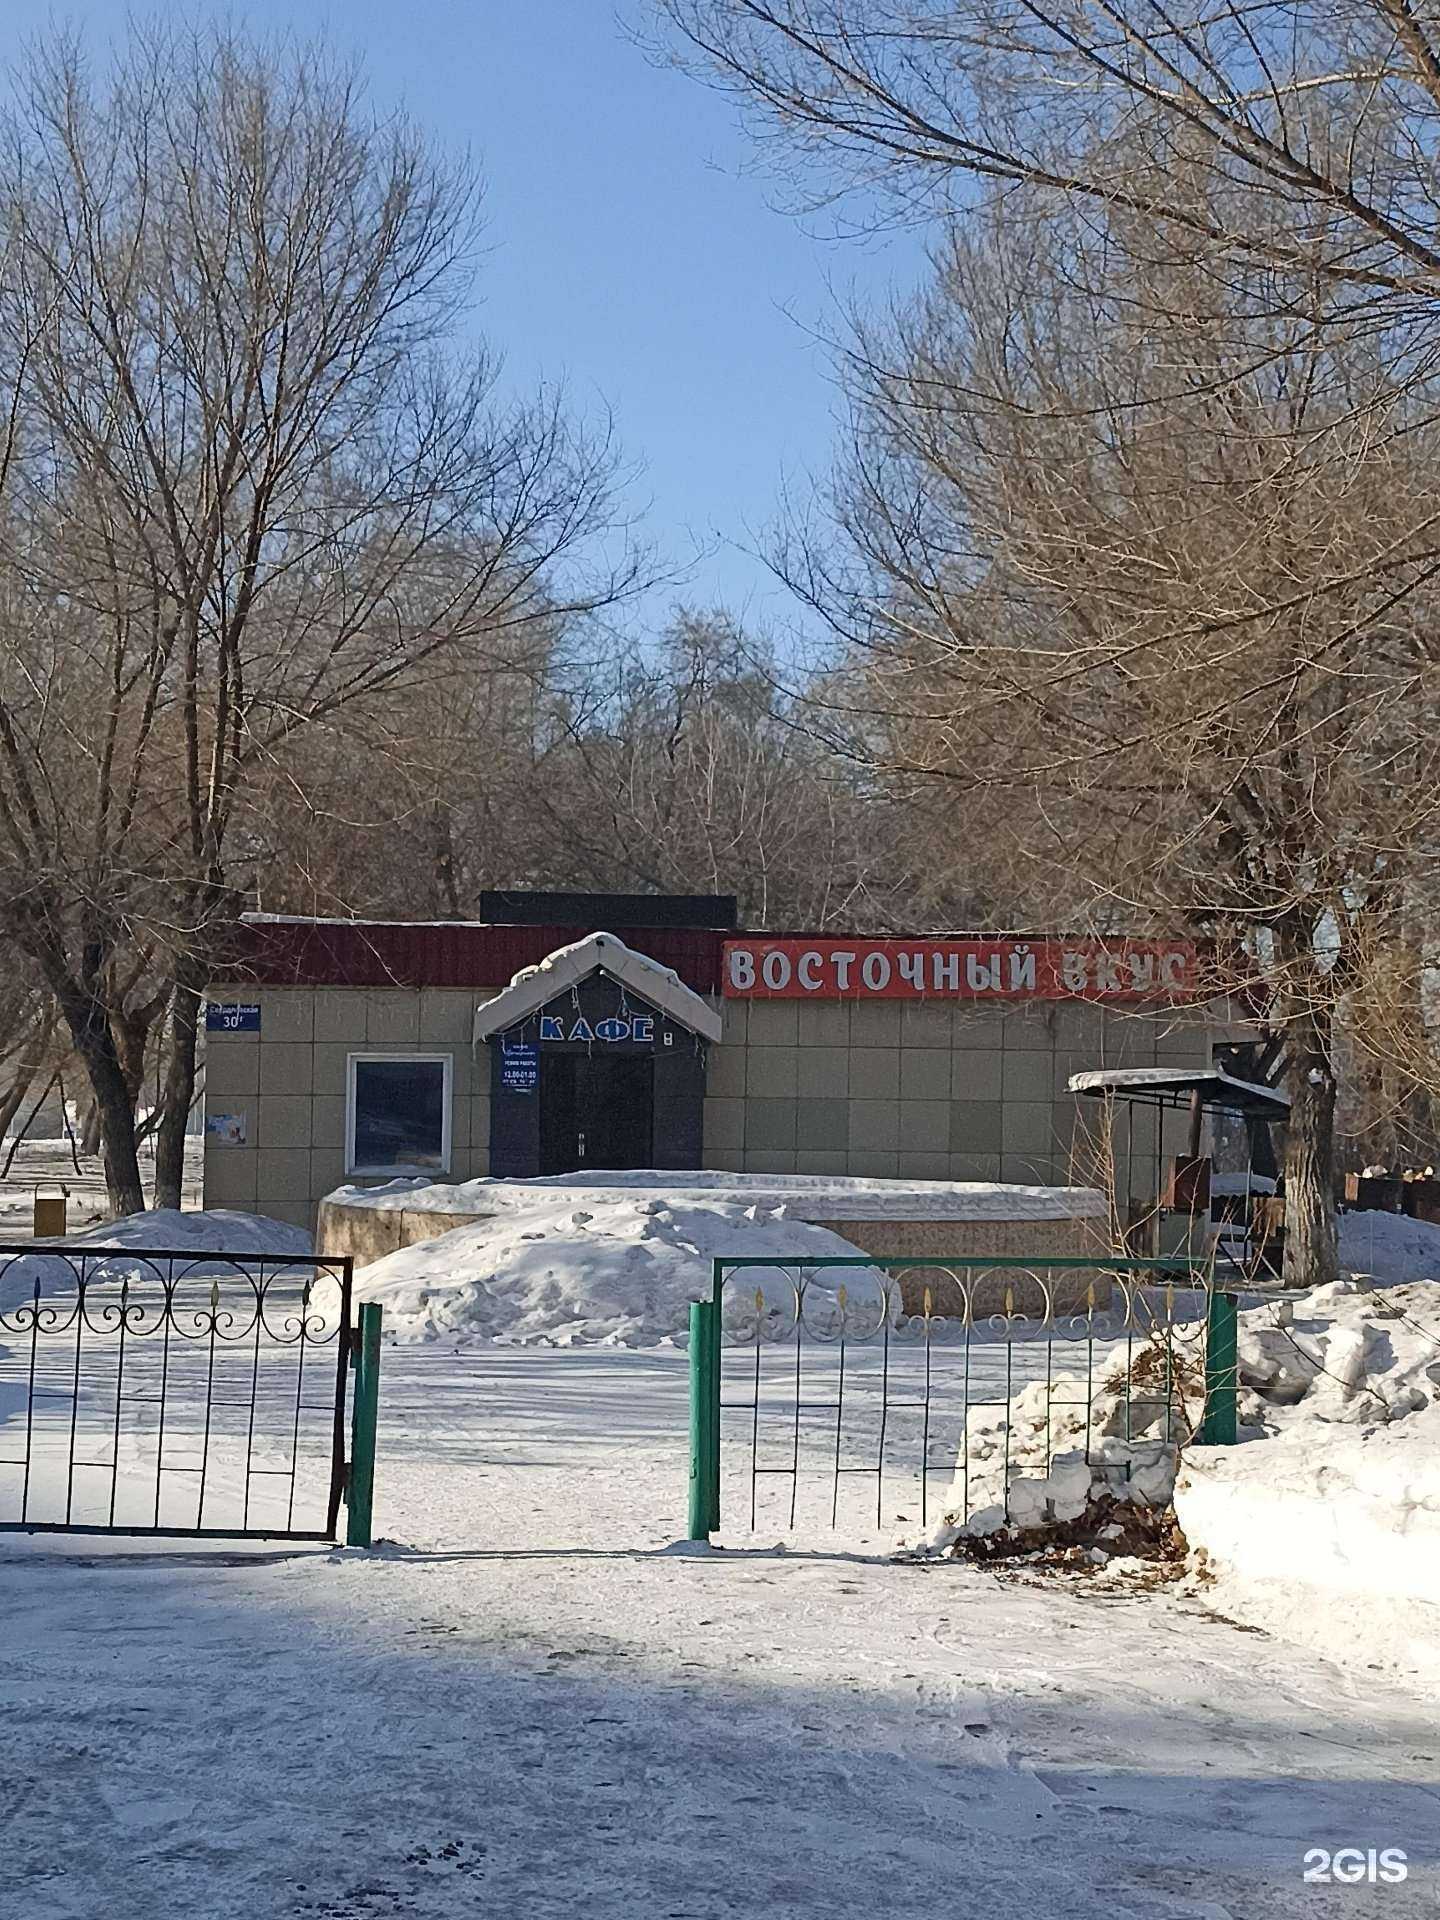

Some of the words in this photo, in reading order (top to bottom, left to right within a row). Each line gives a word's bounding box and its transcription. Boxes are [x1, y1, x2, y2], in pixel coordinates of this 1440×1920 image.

[730, 944, 1036, 991] ВОСТОЧНЫЙ
[1061, 950, 1186, 992] ВКУС
[540, 1016, 654, 1041] КАФЕ
